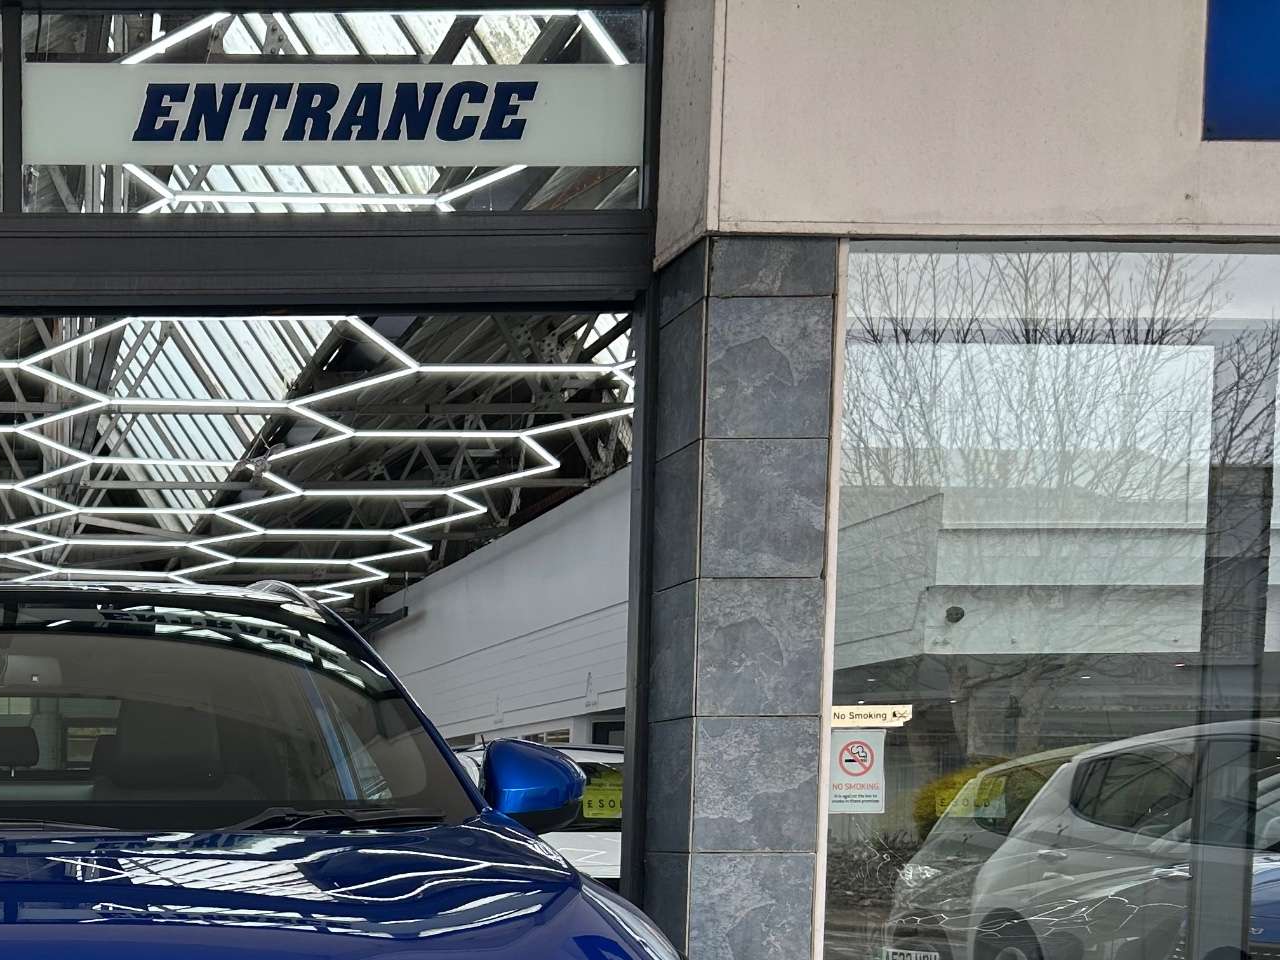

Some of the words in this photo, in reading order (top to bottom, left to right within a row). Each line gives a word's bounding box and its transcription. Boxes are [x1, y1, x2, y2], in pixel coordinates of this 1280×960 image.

[131, 80, 539, 142] ENTRANCE
[833, 712, 846, 720] No
[849, 711, 887, 721] Smoking
[832, 783, 843, 791] NO
[845, 783, 880, 791] SMOKING
